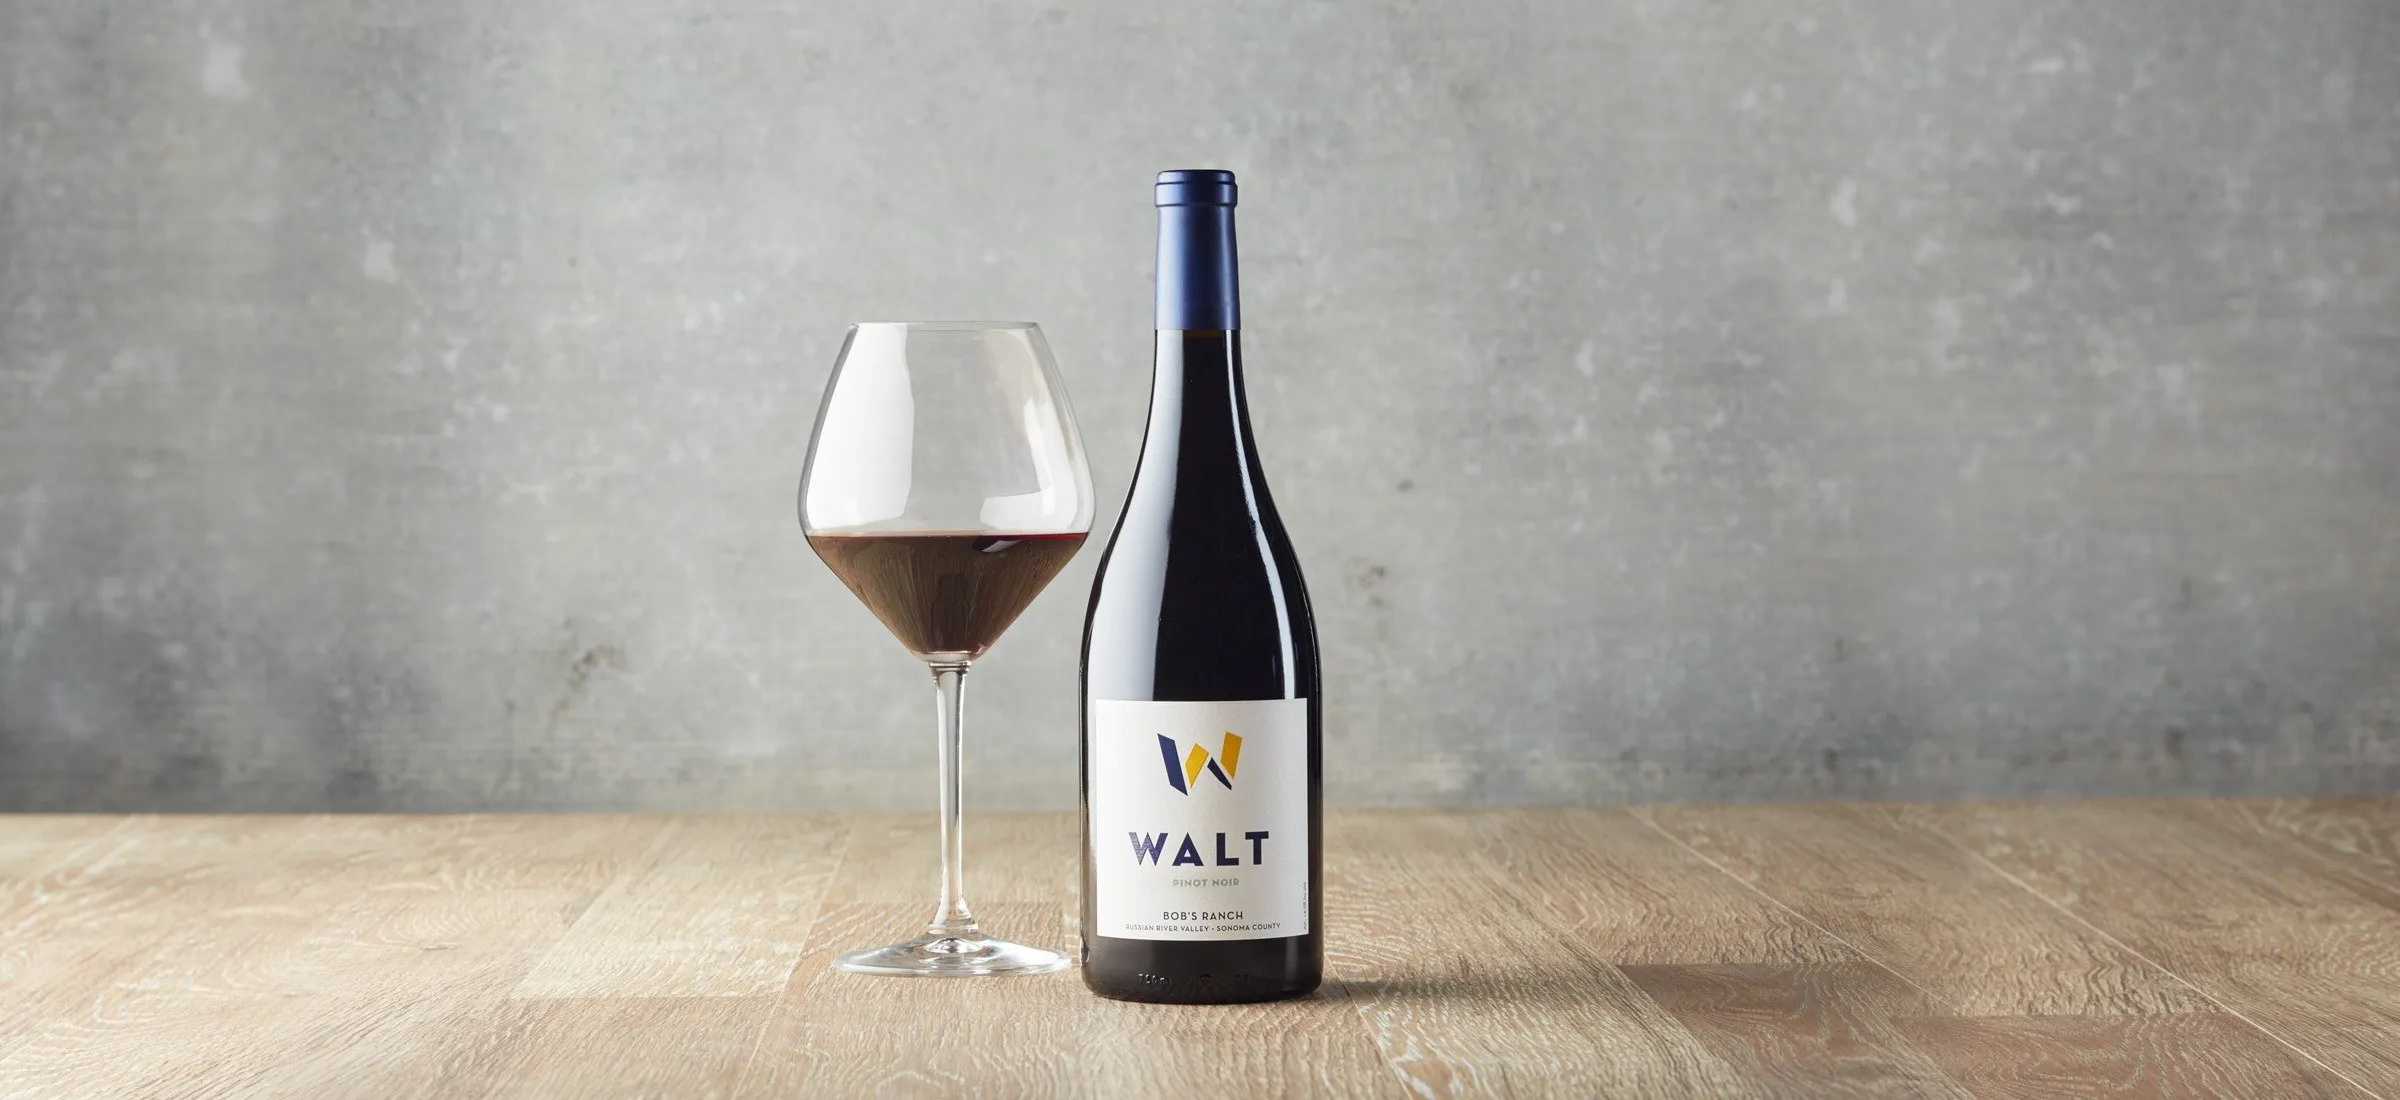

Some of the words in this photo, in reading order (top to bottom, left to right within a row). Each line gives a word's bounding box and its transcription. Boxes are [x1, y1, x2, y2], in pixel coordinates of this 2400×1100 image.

[1157, 731, 1243, 796] W
[1128, 831, 1269, 866] WALT
[1172, 878, 1208, 888] PINOT
[1212, 878, 1240, 887] NOIR
[1163, 911, 1198, 921] BOB'S
[1202, 911, 1244, 921] RANCH
[1125, 923, 1154, 932] RUSSIAN
[1252, 922, 1281, 931] COUNTY
